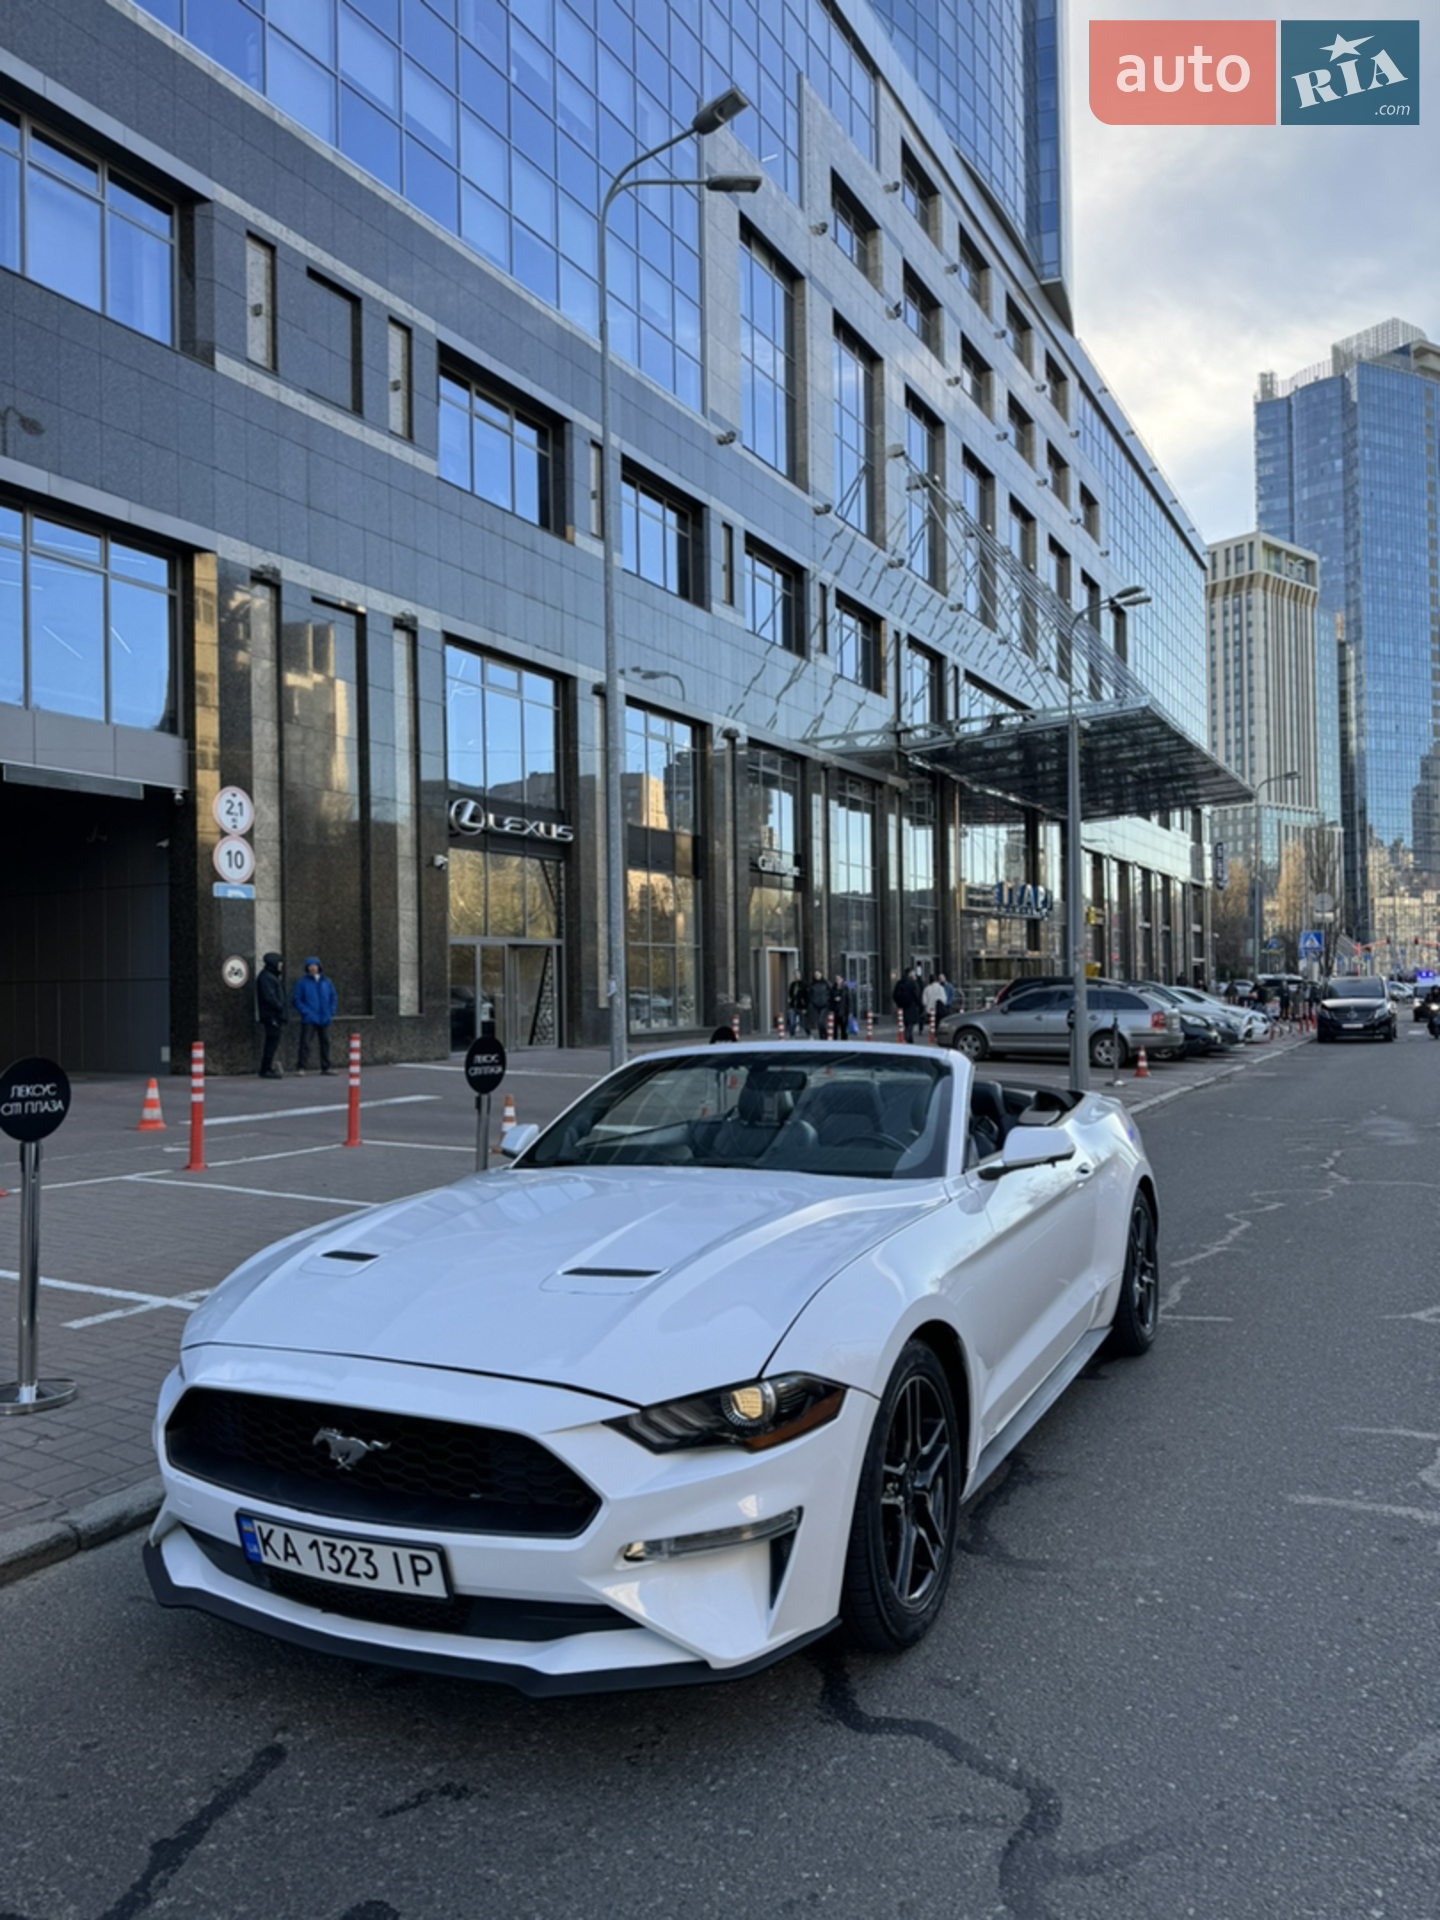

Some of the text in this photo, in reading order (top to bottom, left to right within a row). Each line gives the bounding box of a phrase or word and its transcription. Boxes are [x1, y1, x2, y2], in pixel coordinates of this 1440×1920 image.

[487, 812, 574, 842] LEXUS
[226, 850, 245, 870] 10
[10, 1083, 57, 1099] ЛЕКСУС
[24, 1099, 65, 1114] ПЛАЗА
[257, 1525, 433, 1587] KA 1323 IP
